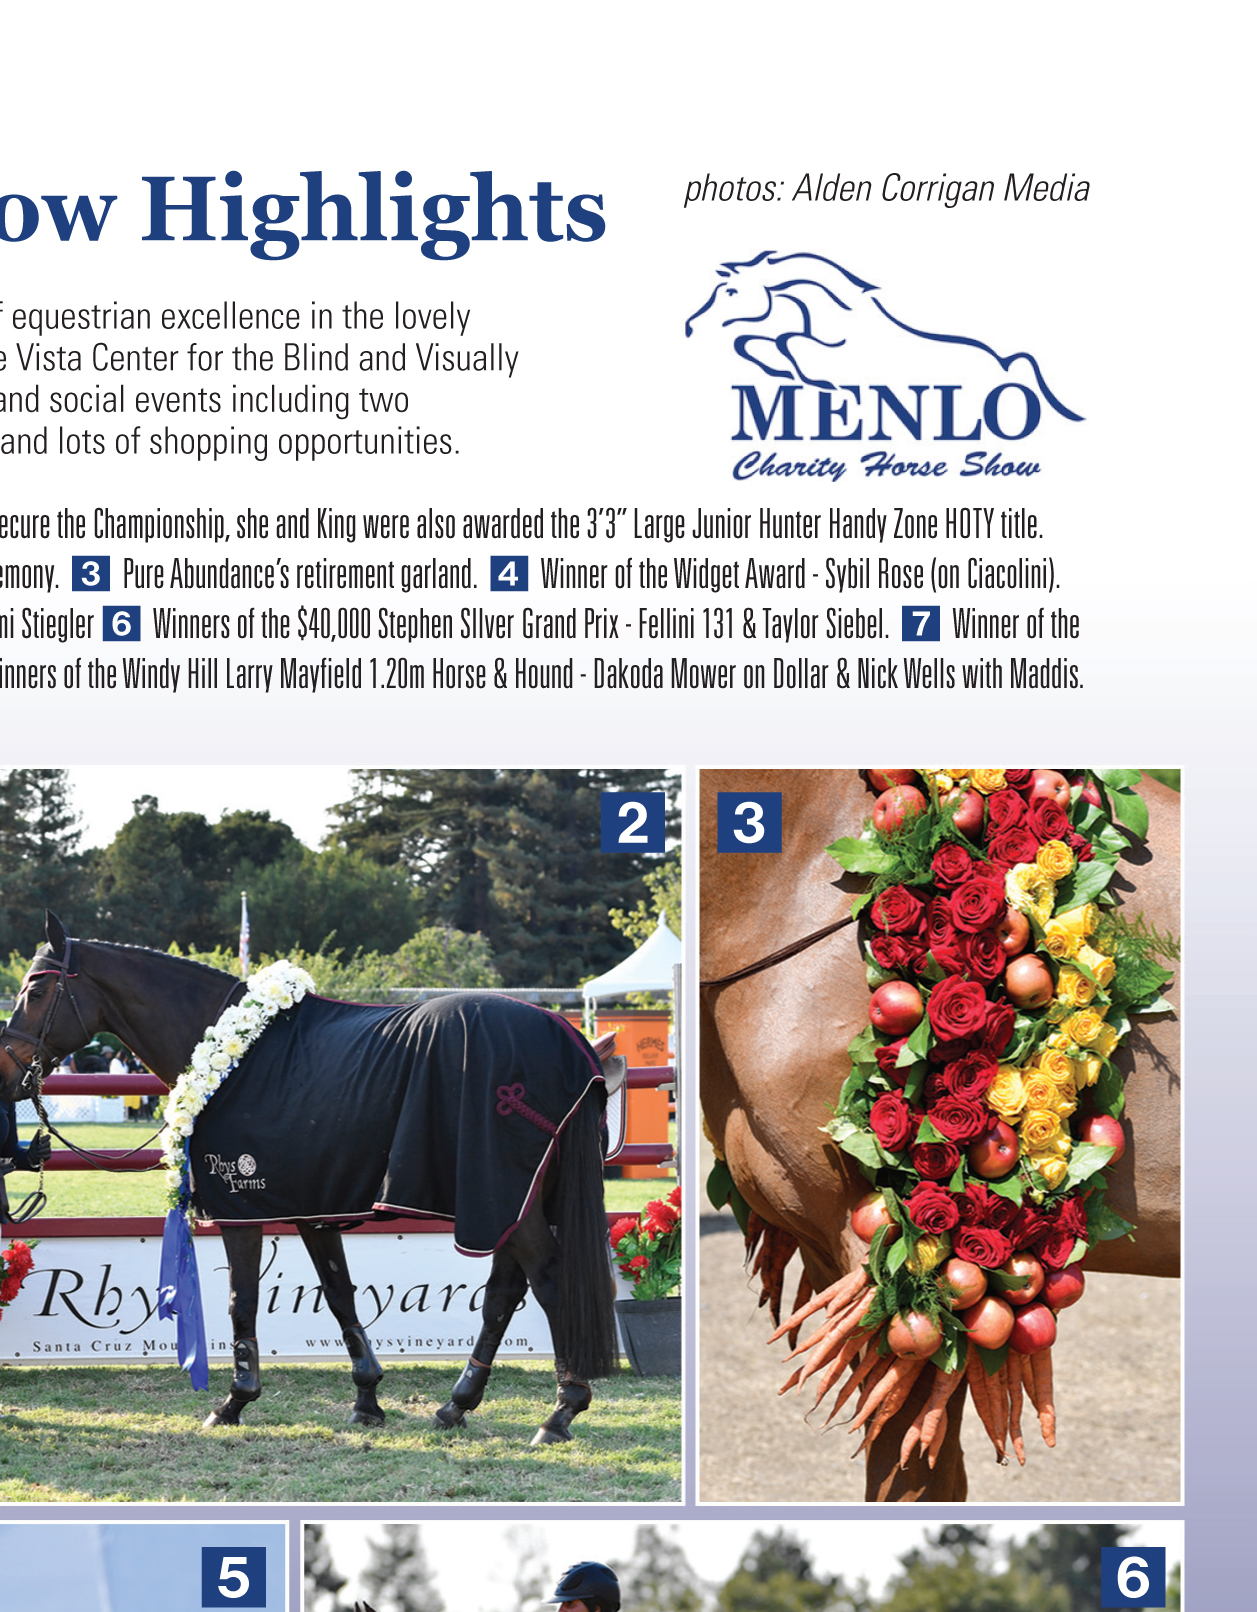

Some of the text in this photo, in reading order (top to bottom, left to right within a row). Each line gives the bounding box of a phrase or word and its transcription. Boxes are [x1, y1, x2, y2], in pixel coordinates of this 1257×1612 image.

[683, 172, 1091, 209] photos: Alden Corrigan Media
[141, 170, 606, 261] Highlights
[12, 300, 151, 337] equestrian
[161, 300, 300, 330] excellence
[311, 300, 333, 330] in
[341, 300, 384, 330] the
[395, 300, 471, 337] lovely
[15, 342, 82, 372] Vista
[92, 342, 179, 372] Center
[186, 342, 224, 372] for
[231, 342, 274, 372] the
[284, 342, 349, 372] Blind
[359, 342, 406, 372] and
[415, 342, 519, 379] Visually
[731, 382, 1041, 441] MENLO
[732, 451, 1041, 482] Charity Horse Show
[82, 561, 100, 586] 3
[123, 557, 164, 589] Pure
[169, 557, 290, 589] Abundance’s
[296, 557, 395, 589] retirement
[401, 557, 478, 594] garland.
[499, 562, 518, 585] 4
[540, 557, 608, 589] Winner
[615, 557, 633, 589] of
[638, 557, 668, 589] the
[673, 557, 740, 594] Widget
[744, 557, 806, 589] Award
[825, 557, 870, 594] Sybil
[878, 557, 924, 589] Rose
[930, 556, 960, 594] (on
[967, 556, 1060, 594] Ciacolini).
[205, 1154, 236, 1182] Rhys
[224, 1172, 266, 1193] Farms
[20, 1264, 181, 1334] Rhy
[32, 1339, 235, 1352] Santa Cruz Mouins
